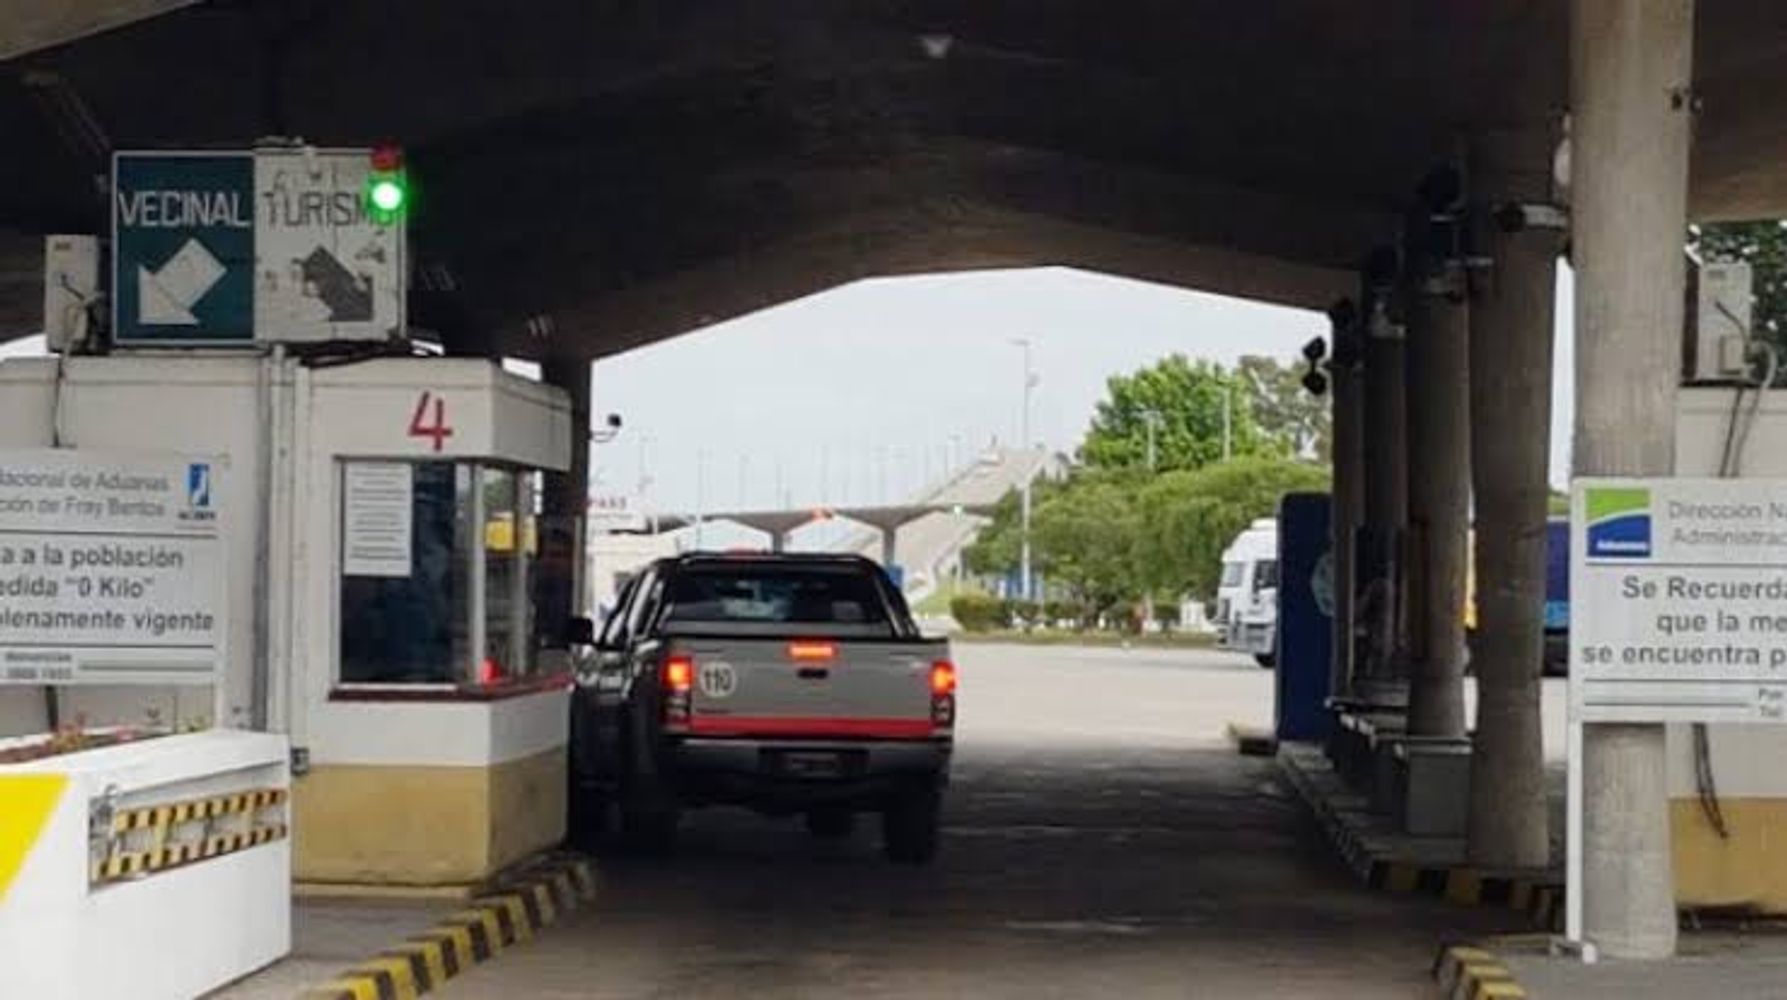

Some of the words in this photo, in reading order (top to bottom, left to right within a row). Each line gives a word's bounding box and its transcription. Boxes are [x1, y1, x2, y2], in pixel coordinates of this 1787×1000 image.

[118, 191, 251, 227] VECINAL
[408, 391, 453, 451] 4
[1668, 499, 1761, 519] Dirección
[22, 547, 36, 565] a
[43, 542, 64, 565] la
[70, 544, 183, 569] población
[1623, 575, 1656, 599] Se
[132, 609, 214, 635] vigente
[1657, 615, 1708, 636] que
[1717, 608, 1740, 632] la
[1583, 647, 1612, 665] se
[1622, 643, 1760, 666] encuentra
